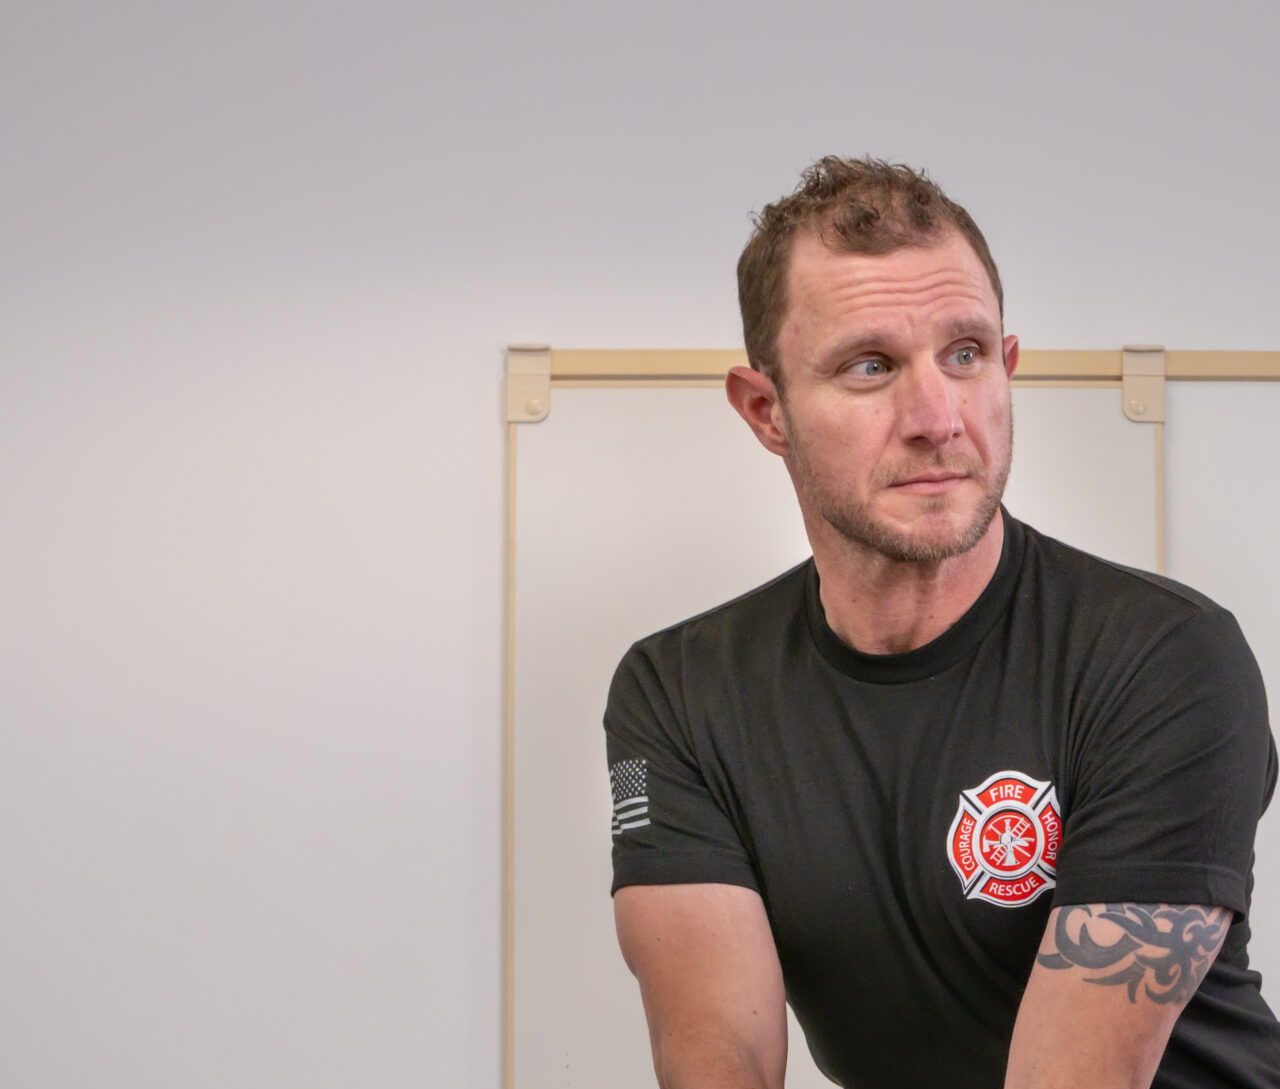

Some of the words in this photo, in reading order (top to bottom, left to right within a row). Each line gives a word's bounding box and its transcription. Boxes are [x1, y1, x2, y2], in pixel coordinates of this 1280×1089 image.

[989, 784, 1025, 802] FIRE
[958, 817, 976, 871] COURAGE
[1041, 810, 1060, 861] HONOR
[988, 876, 1040, 897] RESCUE
